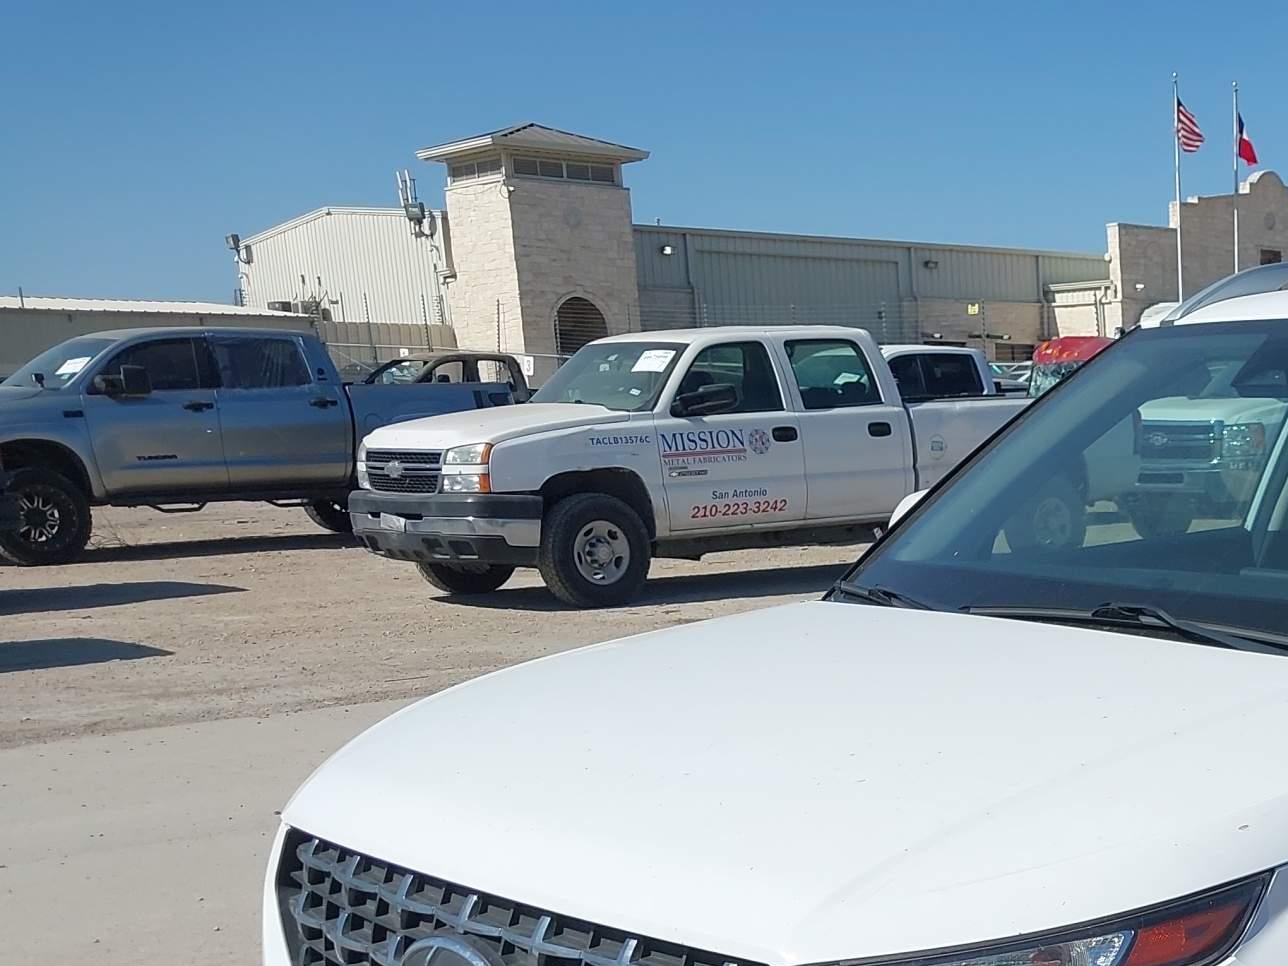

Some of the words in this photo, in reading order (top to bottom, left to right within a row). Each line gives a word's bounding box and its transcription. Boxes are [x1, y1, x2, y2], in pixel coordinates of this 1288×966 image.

[589, 435, 651, 446] TACLB13576C
[661, 429, 746, 452] MISSION
[663, 458, 691, 467] METAL
[691, 454, 748, 465] FABRICATORS
[712, 489, 730, 500] San
[732, 487, 768, 500] Antonio
[691, 499, 788, 520] 210-223-3242
